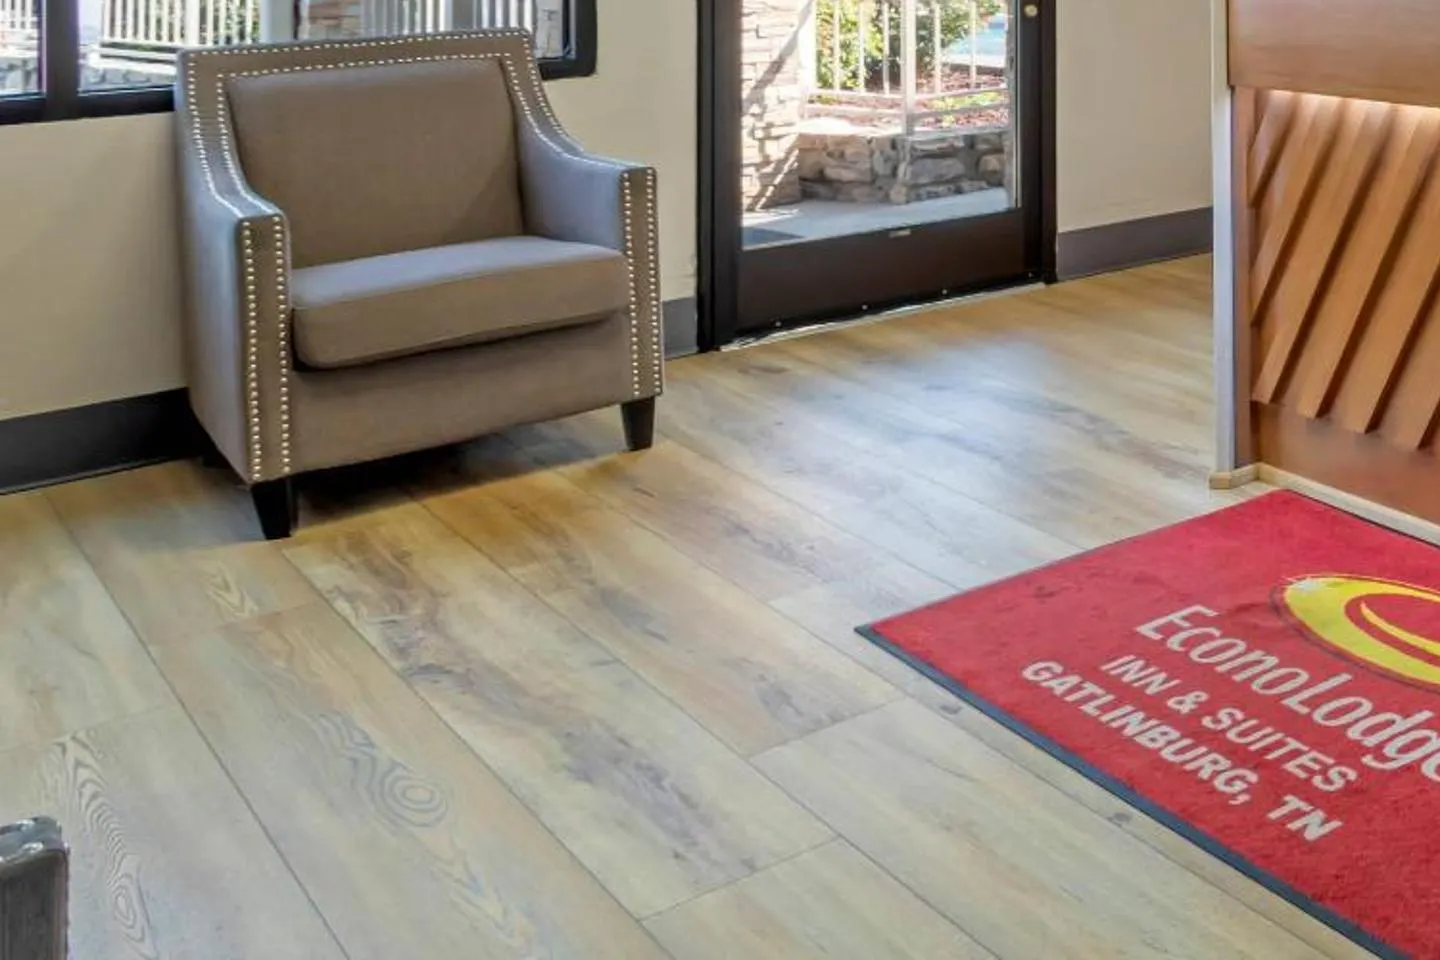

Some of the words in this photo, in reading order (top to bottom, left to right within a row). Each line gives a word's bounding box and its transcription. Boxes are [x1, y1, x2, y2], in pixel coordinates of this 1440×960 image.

[1021, 661, 1259, 806] GATLINBURG,
[1266, 795, 1345, 842] TN
[1101, 654, 1181, 696] INN
[1166, 688, 1210, 714] &
[1202, 707, 1359, 792] SUITES
